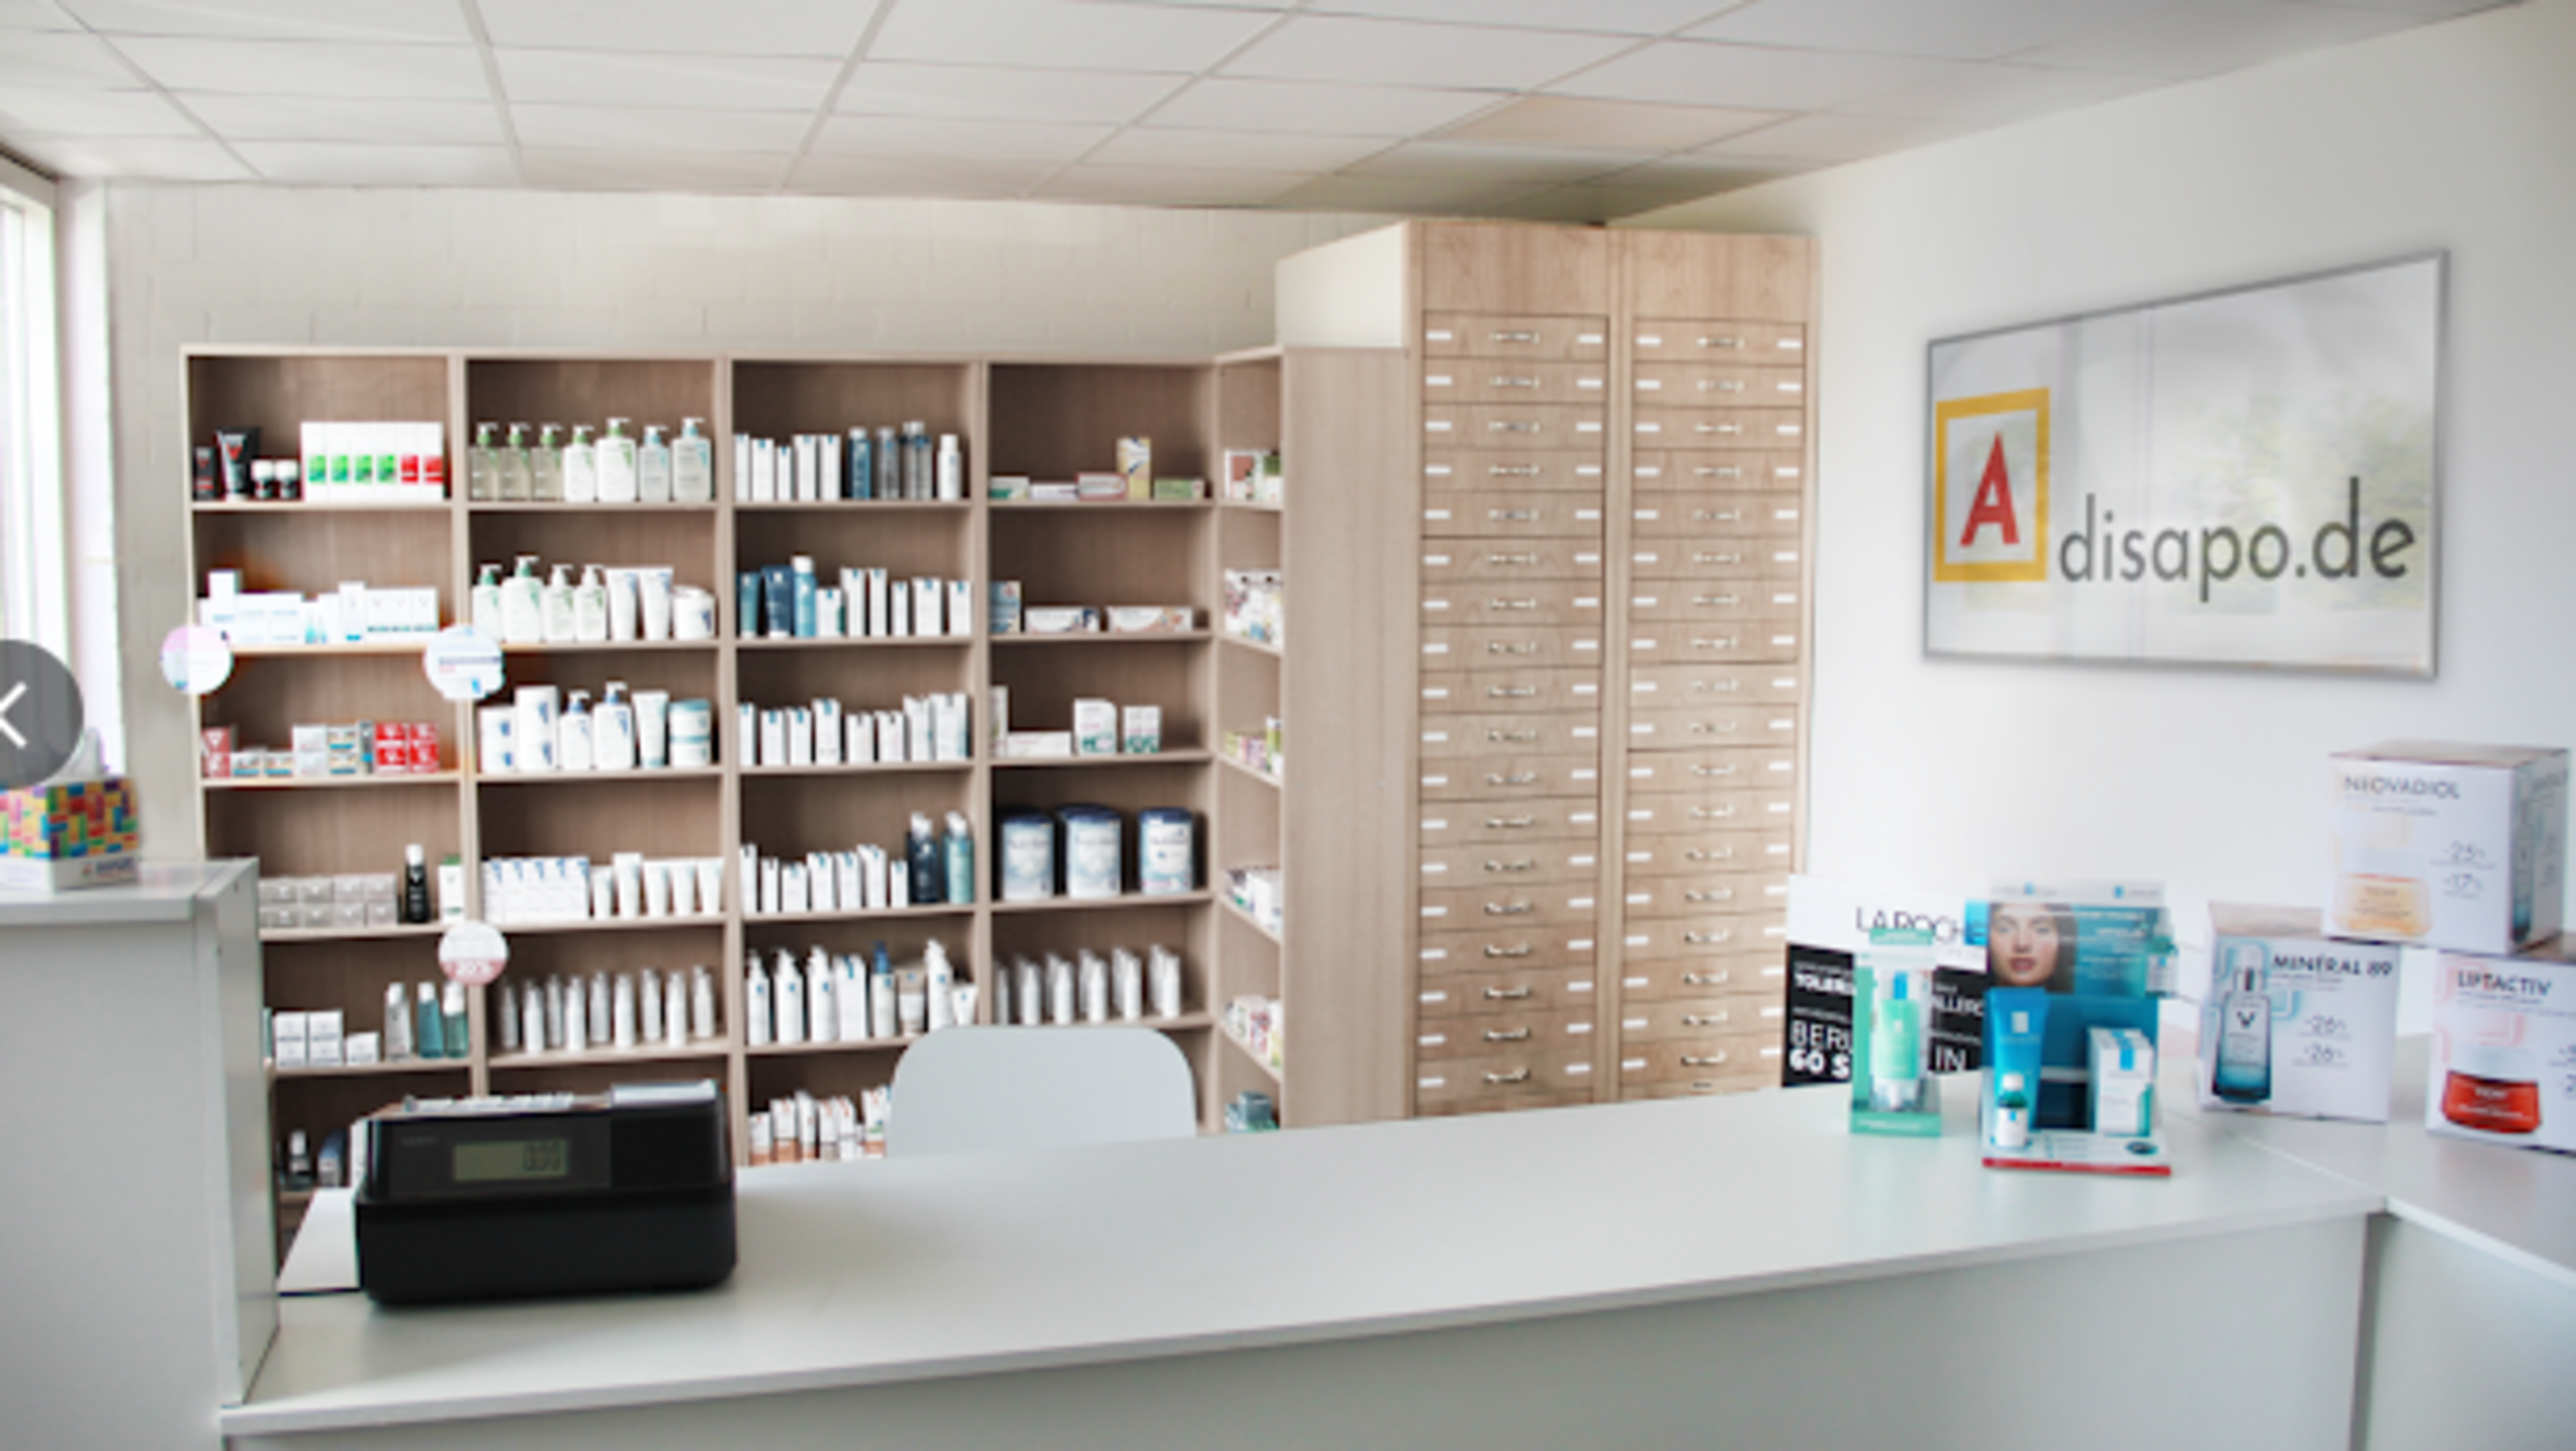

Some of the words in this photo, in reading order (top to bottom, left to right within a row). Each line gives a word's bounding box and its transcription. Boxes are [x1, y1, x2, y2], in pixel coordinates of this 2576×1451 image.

[1960, 431, 2020, 547] A
[2059, 476, 2415, 603] disapo.de
[2366, 960, 2393, 977] 89
[1935, 1044, 1967, 1071] IN
